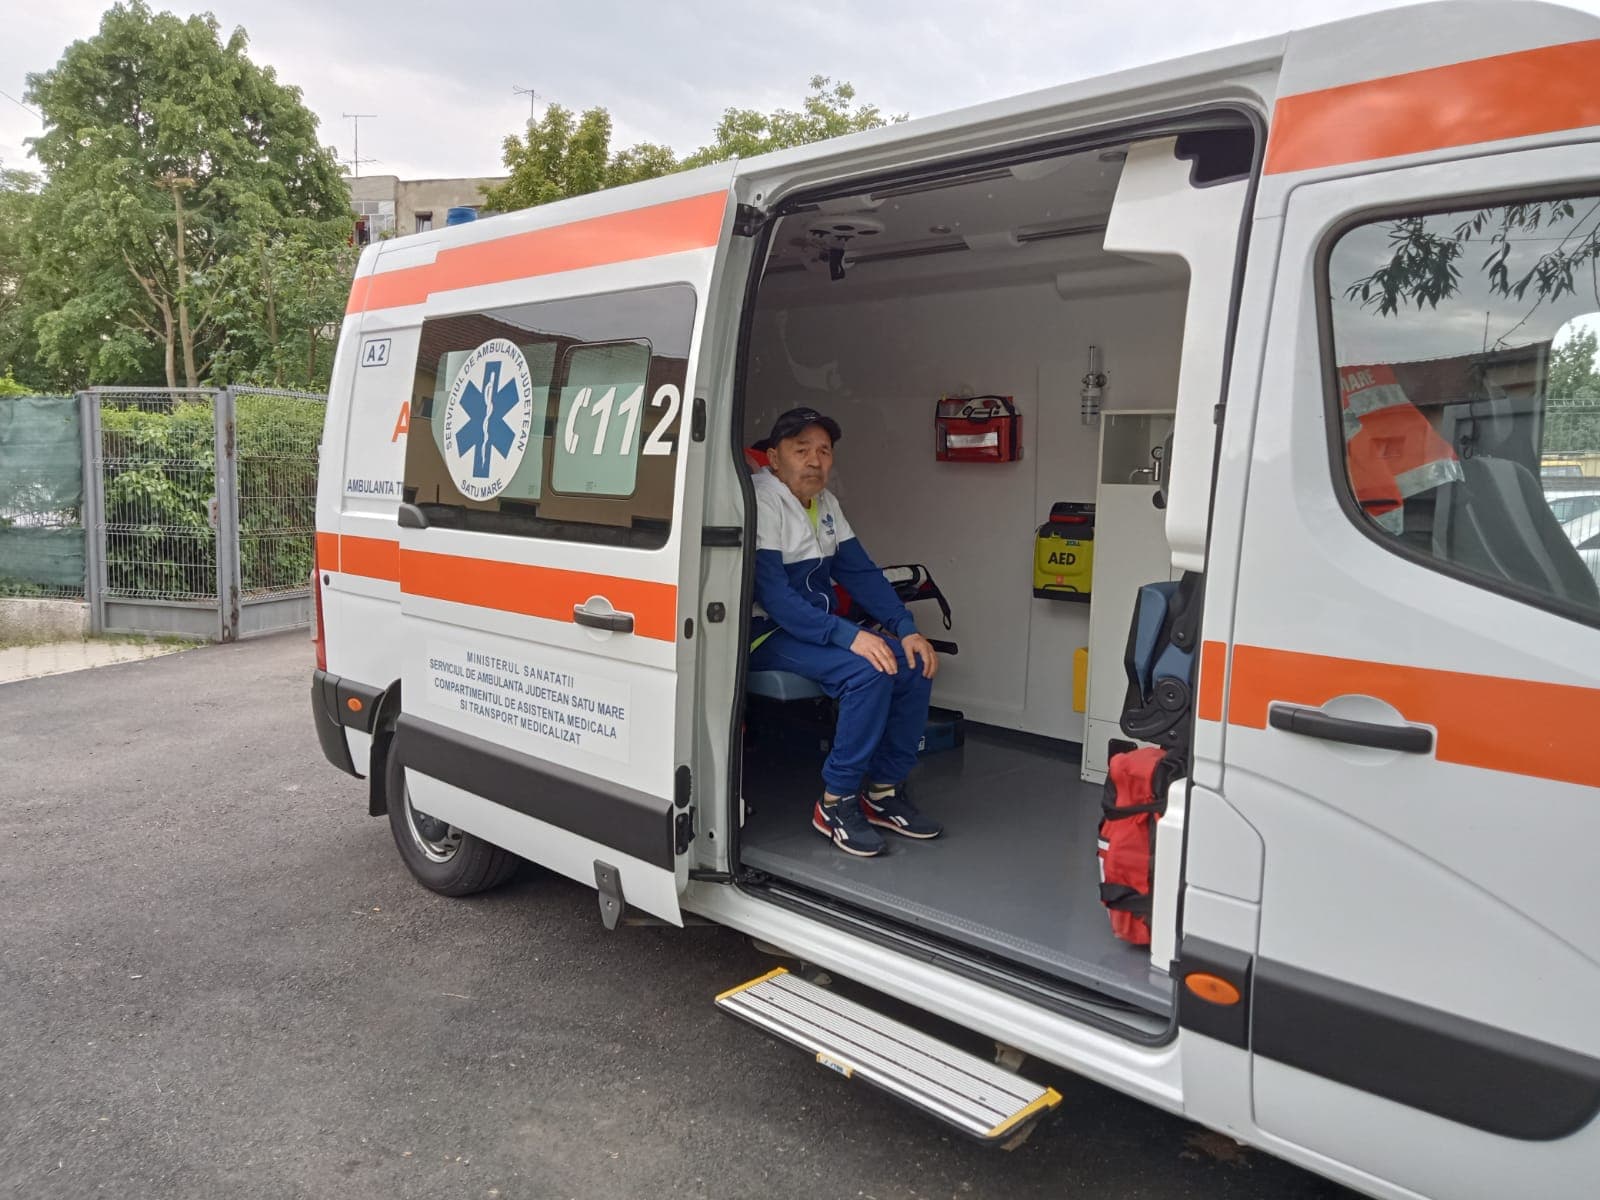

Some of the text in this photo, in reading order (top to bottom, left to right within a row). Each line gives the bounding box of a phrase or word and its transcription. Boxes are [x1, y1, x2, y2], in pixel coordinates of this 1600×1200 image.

[446, 342, 532, 452] SERVICIUL DE AMBULANTA JUDETEAN
[591, 384, 681, 456] 112
[347, 479, 394, 495] AMBULANTA
[460, 478, 503, 498] SATU MARE
[1048, 552, 1076, 566] AED
[429, 658, 625, 720] SERVICIUL DE AMBULANTA JUDETEAN SATU MARE
[467, 651, 574, 688] MINISTERUL SANATATII
[434, 677, 617, 739] COMPARTIMENTUL DE ASISTENTA MEDICALA
[460, 699, 581, 745] SI TRANSPORT MEDICALIZAT
